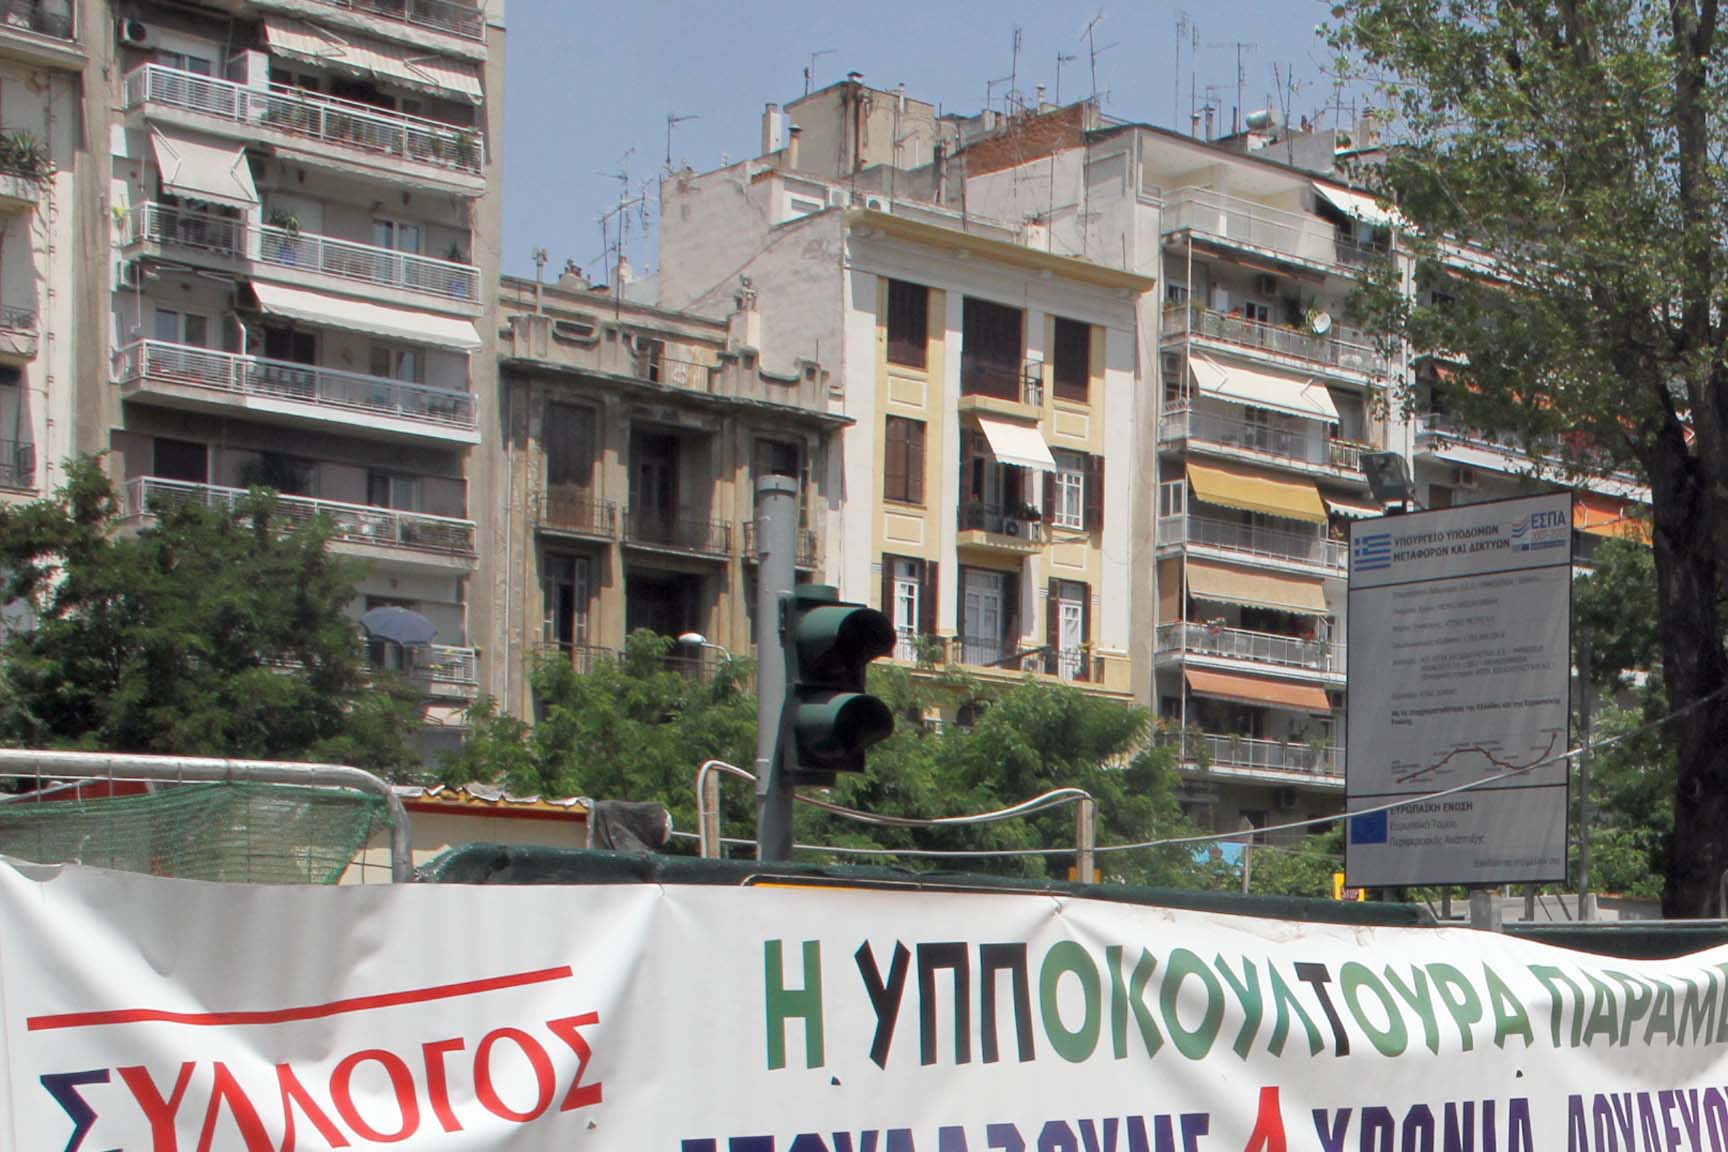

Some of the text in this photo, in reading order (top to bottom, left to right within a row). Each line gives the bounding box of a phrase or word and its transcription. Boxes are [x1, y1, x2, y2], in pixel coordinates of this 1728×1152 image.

[1531, 511, 1566, 529] ΕΣΠΑ
[1394, 525, 1499, 548] ΥΠΟΥΡΓΕΙΟ ΥΠΟΔΟΜΩΝ
[1393, 538, 1511, 562] ΜΕΤΑΦΟΡΩΝ ΚΑΙ ΔΙΚΤΥΩΝ
[764, 939, 825, 1070] Η
[854, 938, 1534, 1071] ΥΠΠΟΚΟΥΛΤΟΥΡΑ
